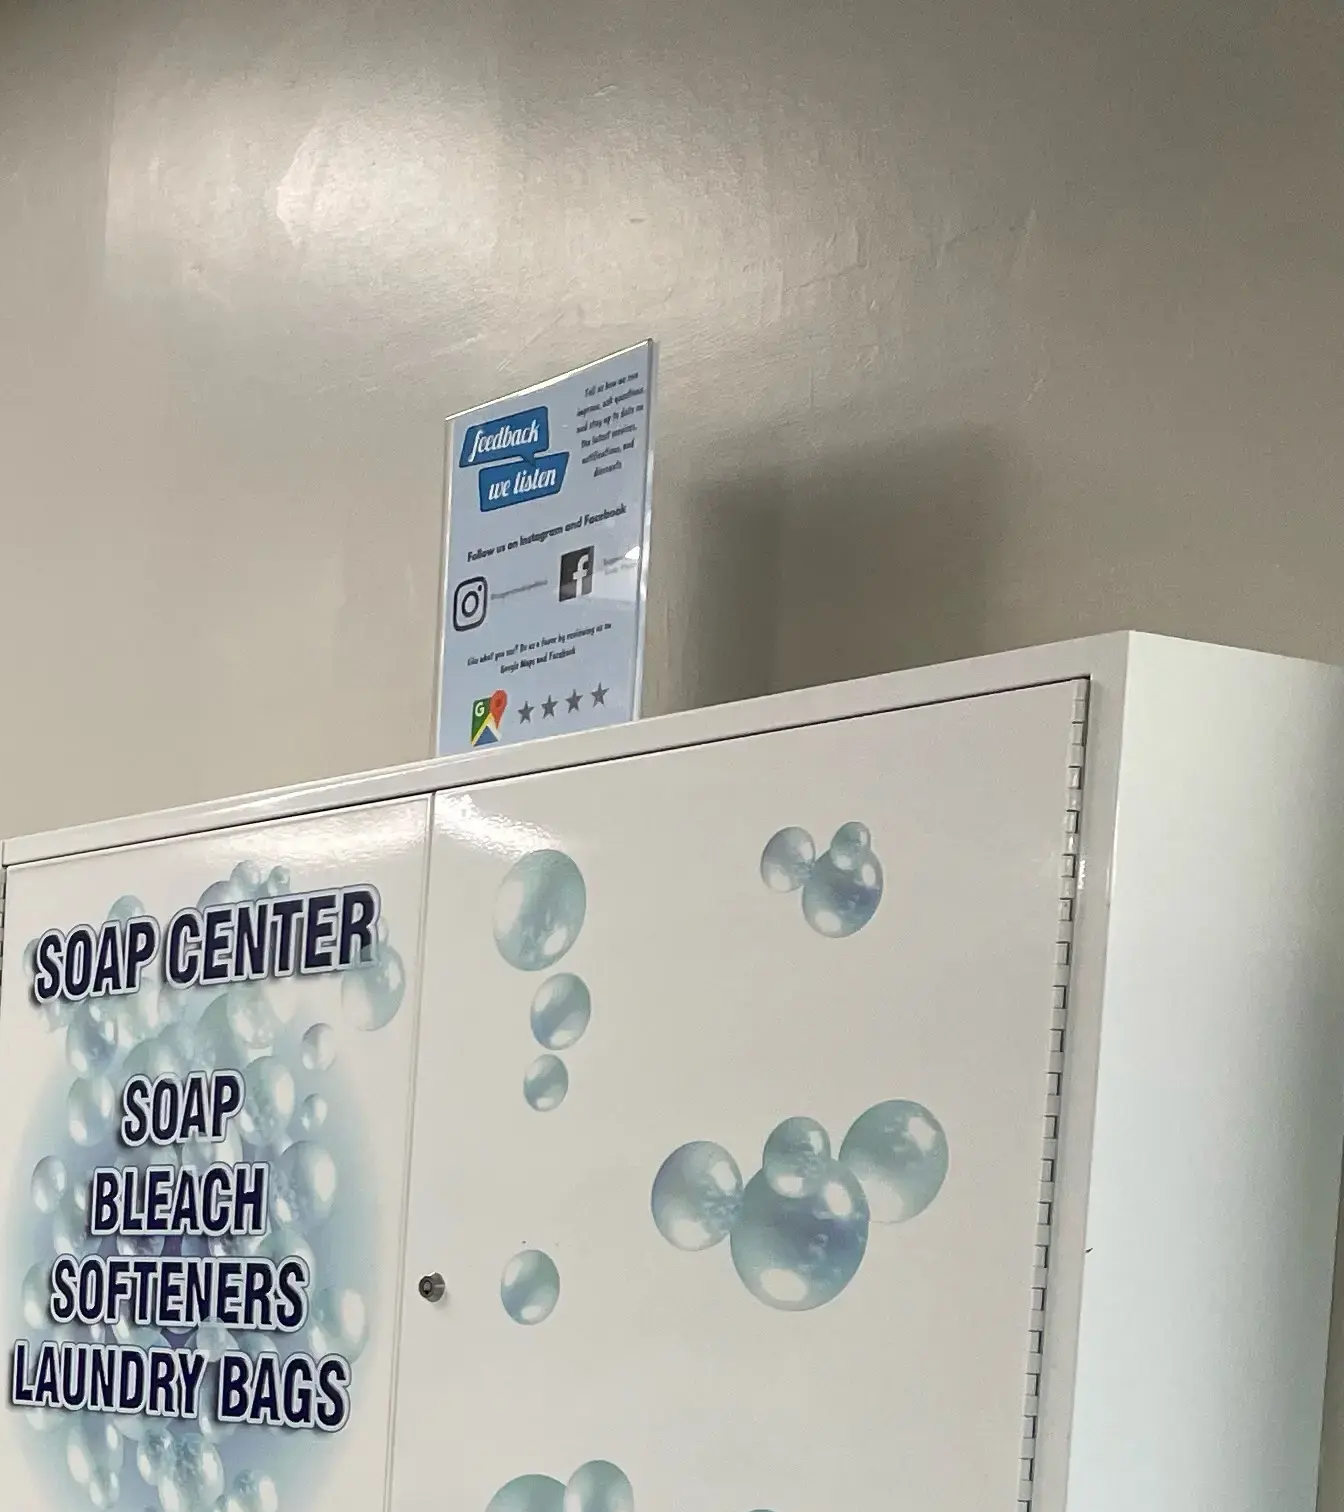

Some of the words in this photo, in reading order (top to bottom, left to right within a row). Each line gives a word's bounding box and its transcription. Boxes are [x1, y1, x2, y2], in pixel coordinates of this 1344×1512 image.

[468, 419, 540, 463] feedback
[488, 479, 511, 501] we
[513, 468, 557, 495] listen
[467, 548, 496, 563] Follow
[496, 545, 506, 554] us
[507, 541, 518, 551] on
[519, 525, 564, 546] Instagram
[564, 516, 583, 532] and
[583, 502, 628, 527] Facebook
[36, 918, 159, 999] SOAP
[167, 889, 379, 984] CENTER
[122, 1072, 243, 1142] SOAP
[92, 1165, 268, 1234] BLEACH
[52, 1257, 309, 1331] SOFTENERS
[13, 1341, 208, 1416] LAUNDRY
[218, 1354, 349, 1430] BAGS
